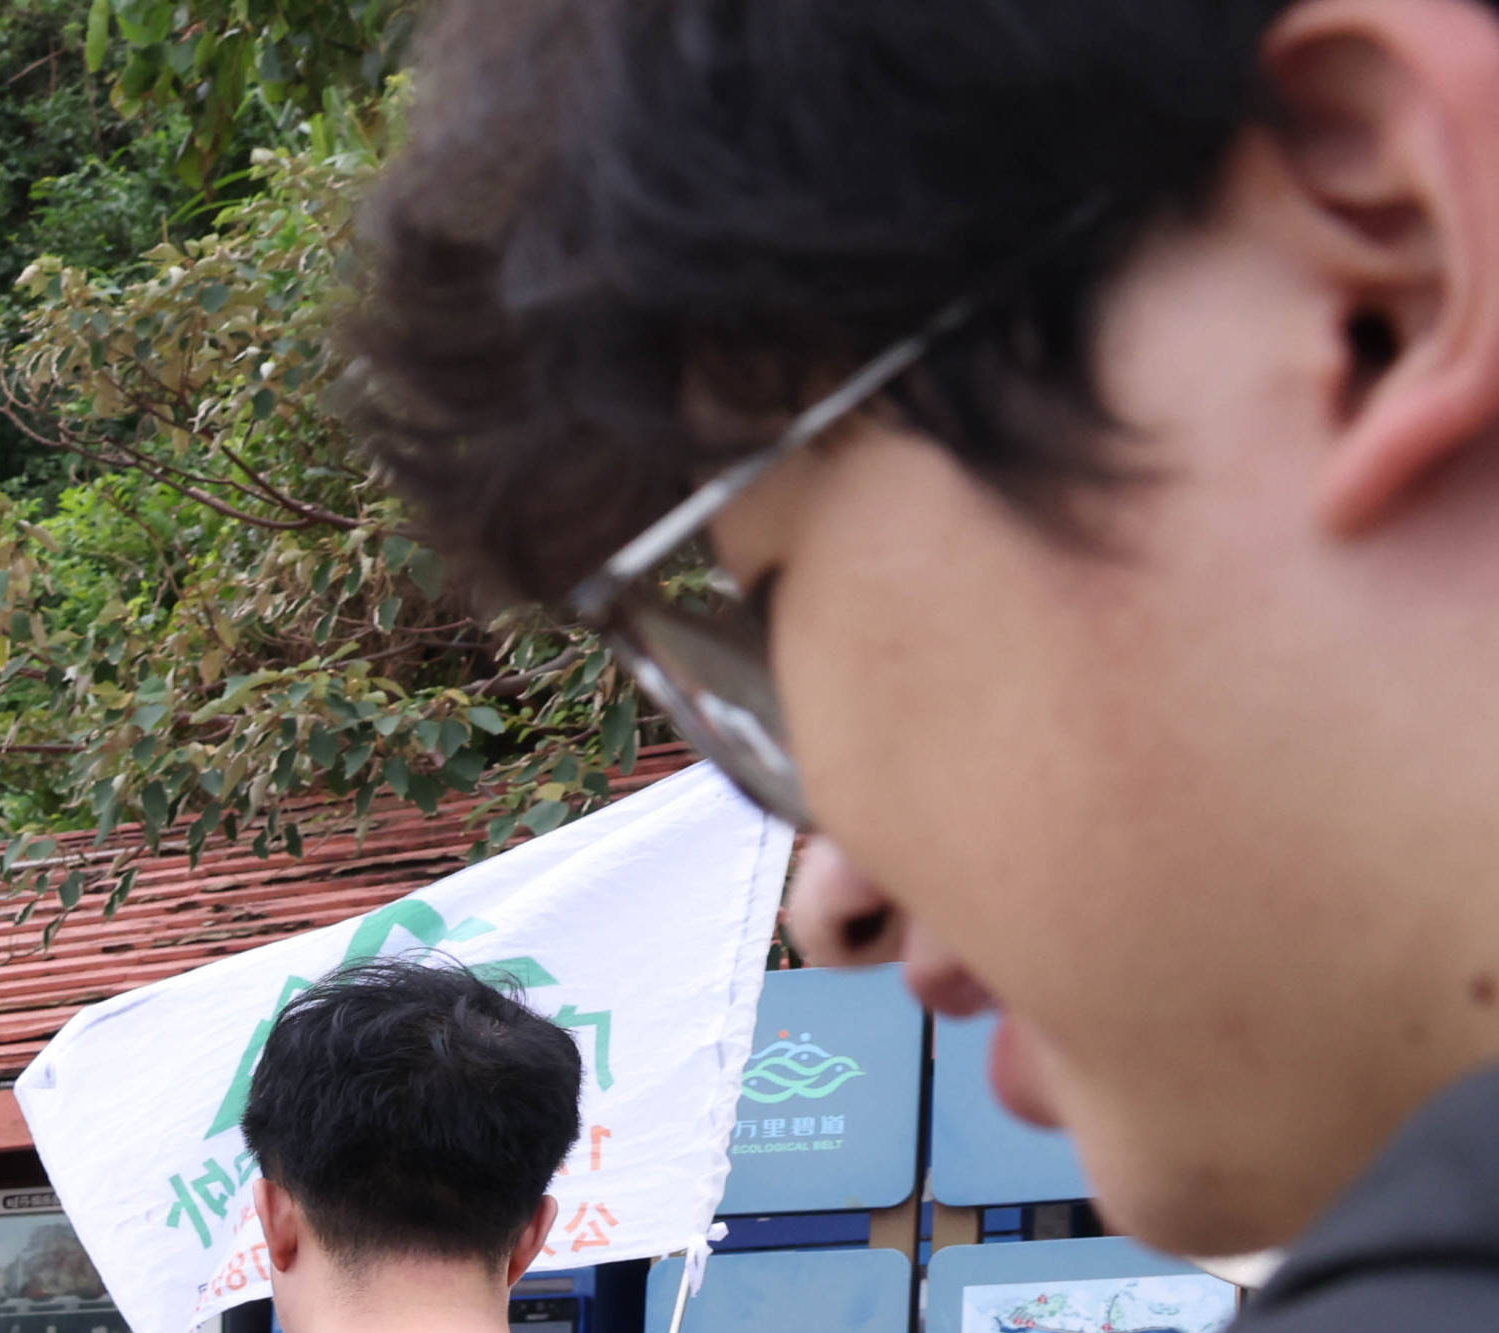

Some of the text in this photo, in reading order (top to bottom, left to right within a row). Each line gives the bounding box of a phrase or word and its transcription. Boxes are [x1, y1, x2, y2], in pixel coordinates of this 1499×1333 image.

[734, 1114, 845, 1138] 万里碧道
[732, 1139, 843, 1154] ECOLOGICAL BELT
